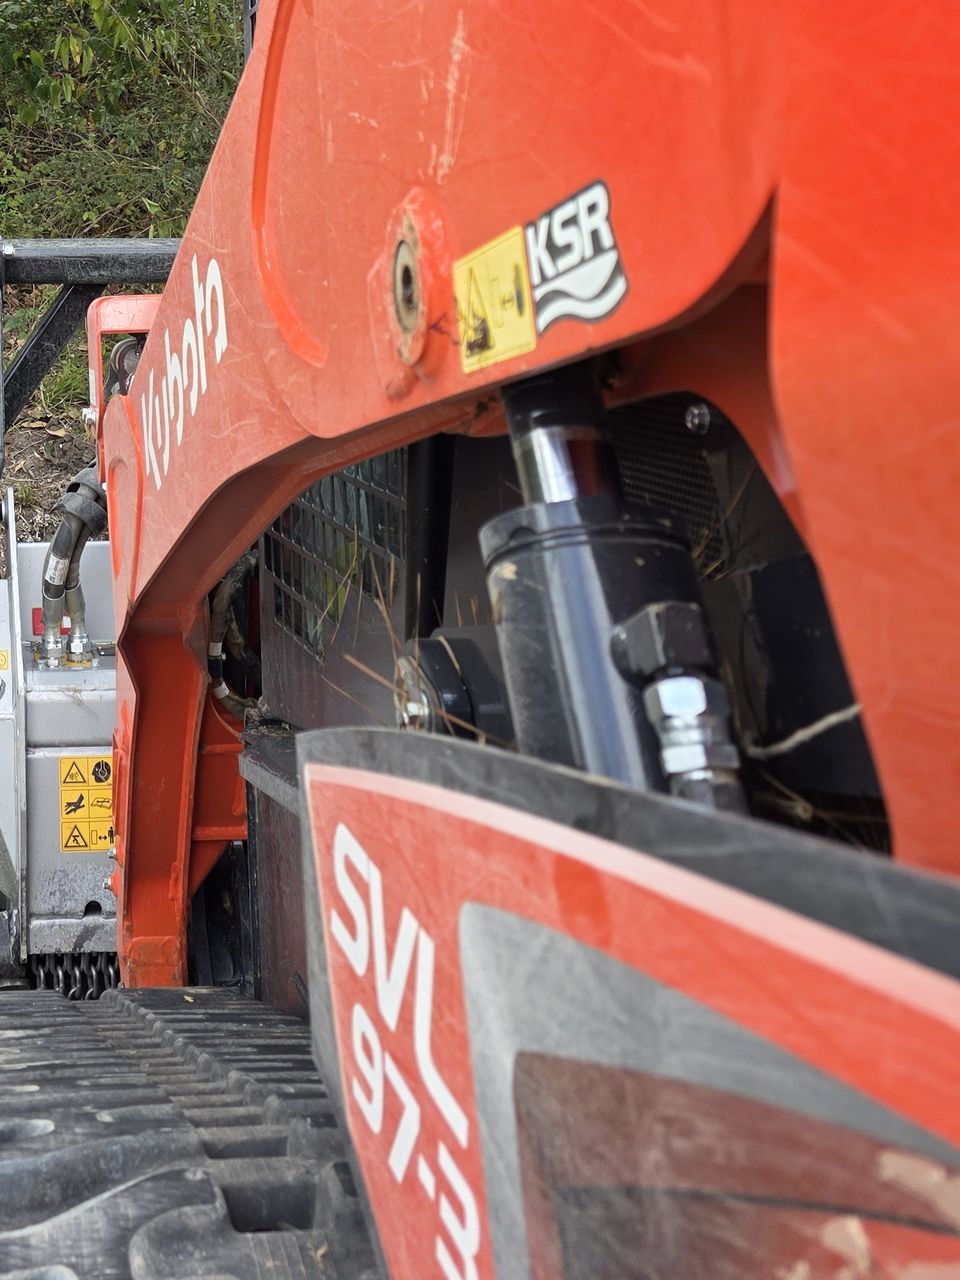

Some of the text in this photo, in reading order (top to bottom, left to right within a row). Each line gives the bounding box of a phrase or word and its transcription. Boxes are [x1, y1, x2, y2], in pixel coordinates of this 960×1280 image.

[526, 183, 615, 287] KSR
[141, 253, 228, 491] Kubota
[331, 823, 469, 1150] SVL
